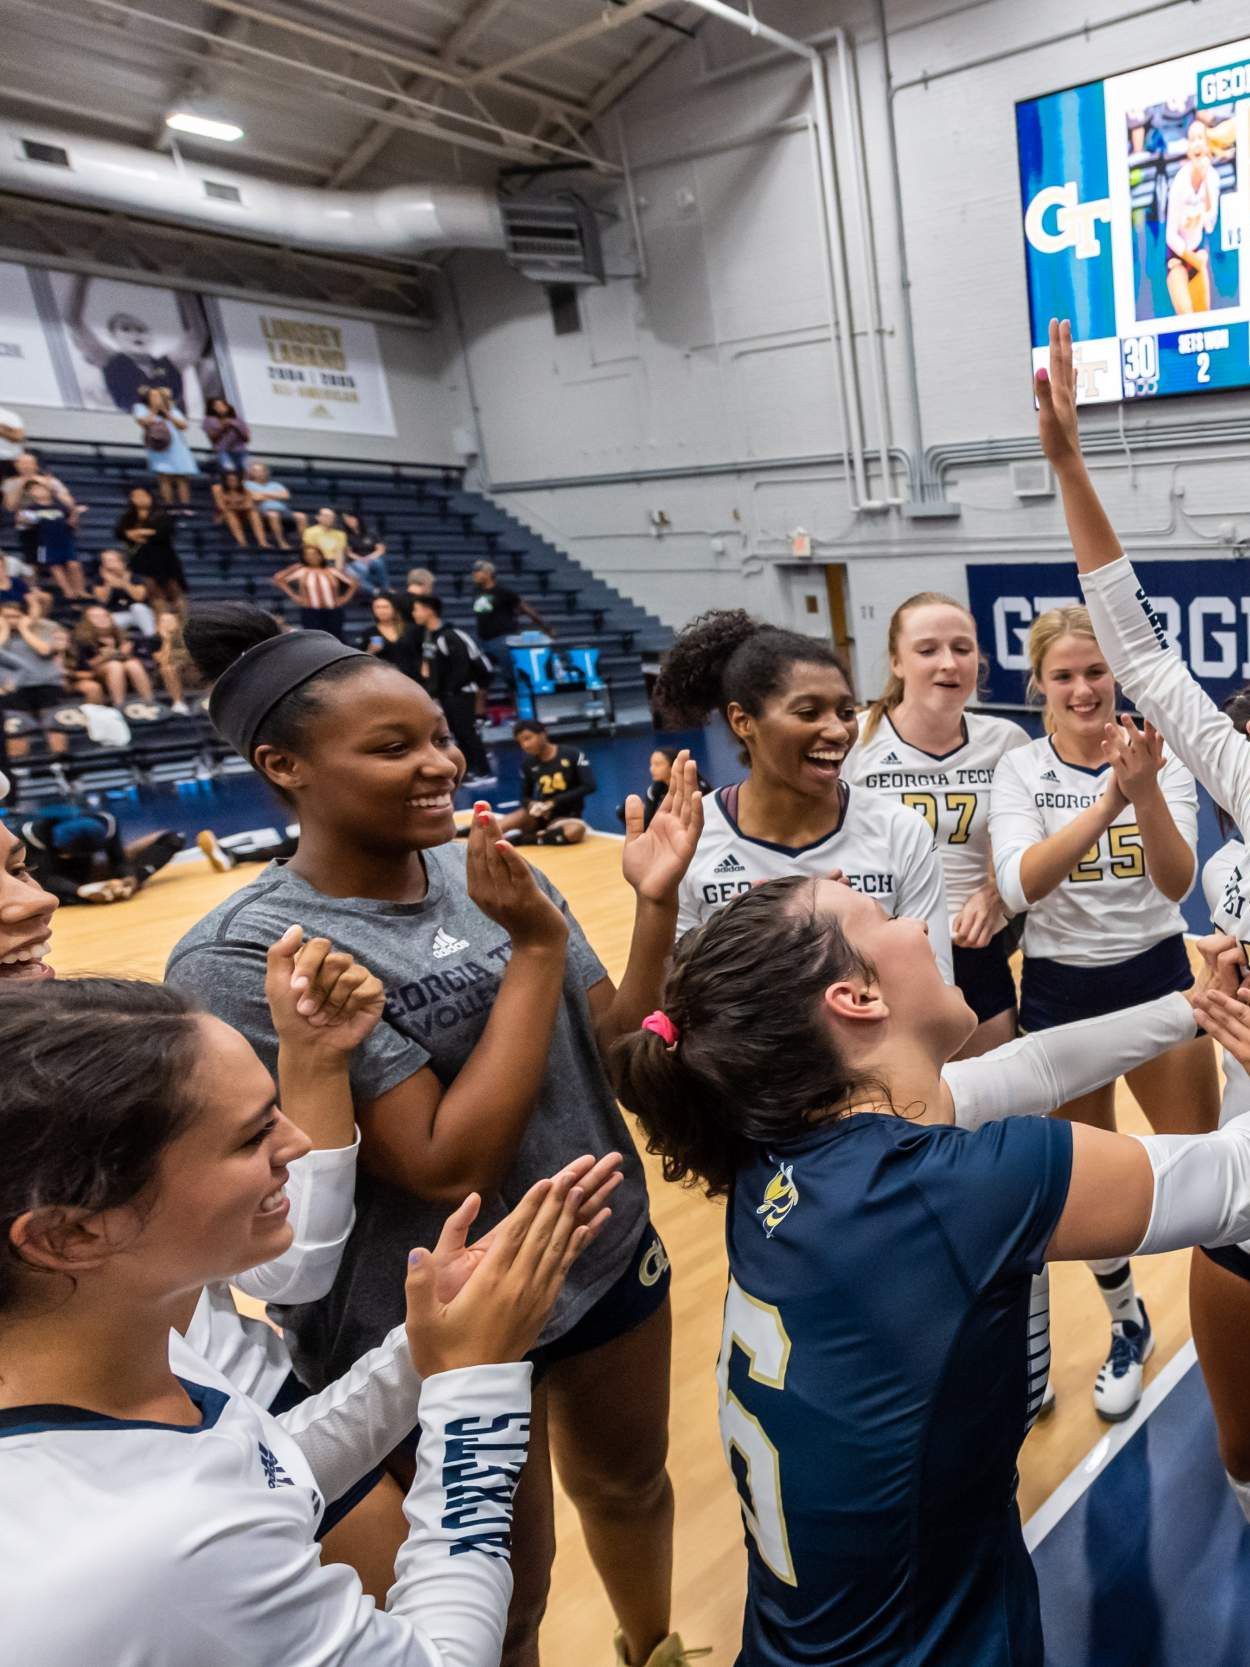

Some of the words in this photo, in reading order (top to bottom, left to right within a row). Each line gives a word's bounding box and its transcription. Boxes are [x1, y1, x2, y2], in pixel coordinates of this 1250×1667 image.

[1228, 224, 1242, 245] VS
[1123, 335, 1156, 380] 30
[1197, 351, 1211, 383] 2
[539, 771, 567, 794] 24
[866, 773, 950, 788] GEORGIA
[713, 865, 746, 874] adidas
[846, 874, 893, 893] ECH
[385, 960, 494, 1018] EORGIA
[441, 1412, 531, 1560] ACKETS
